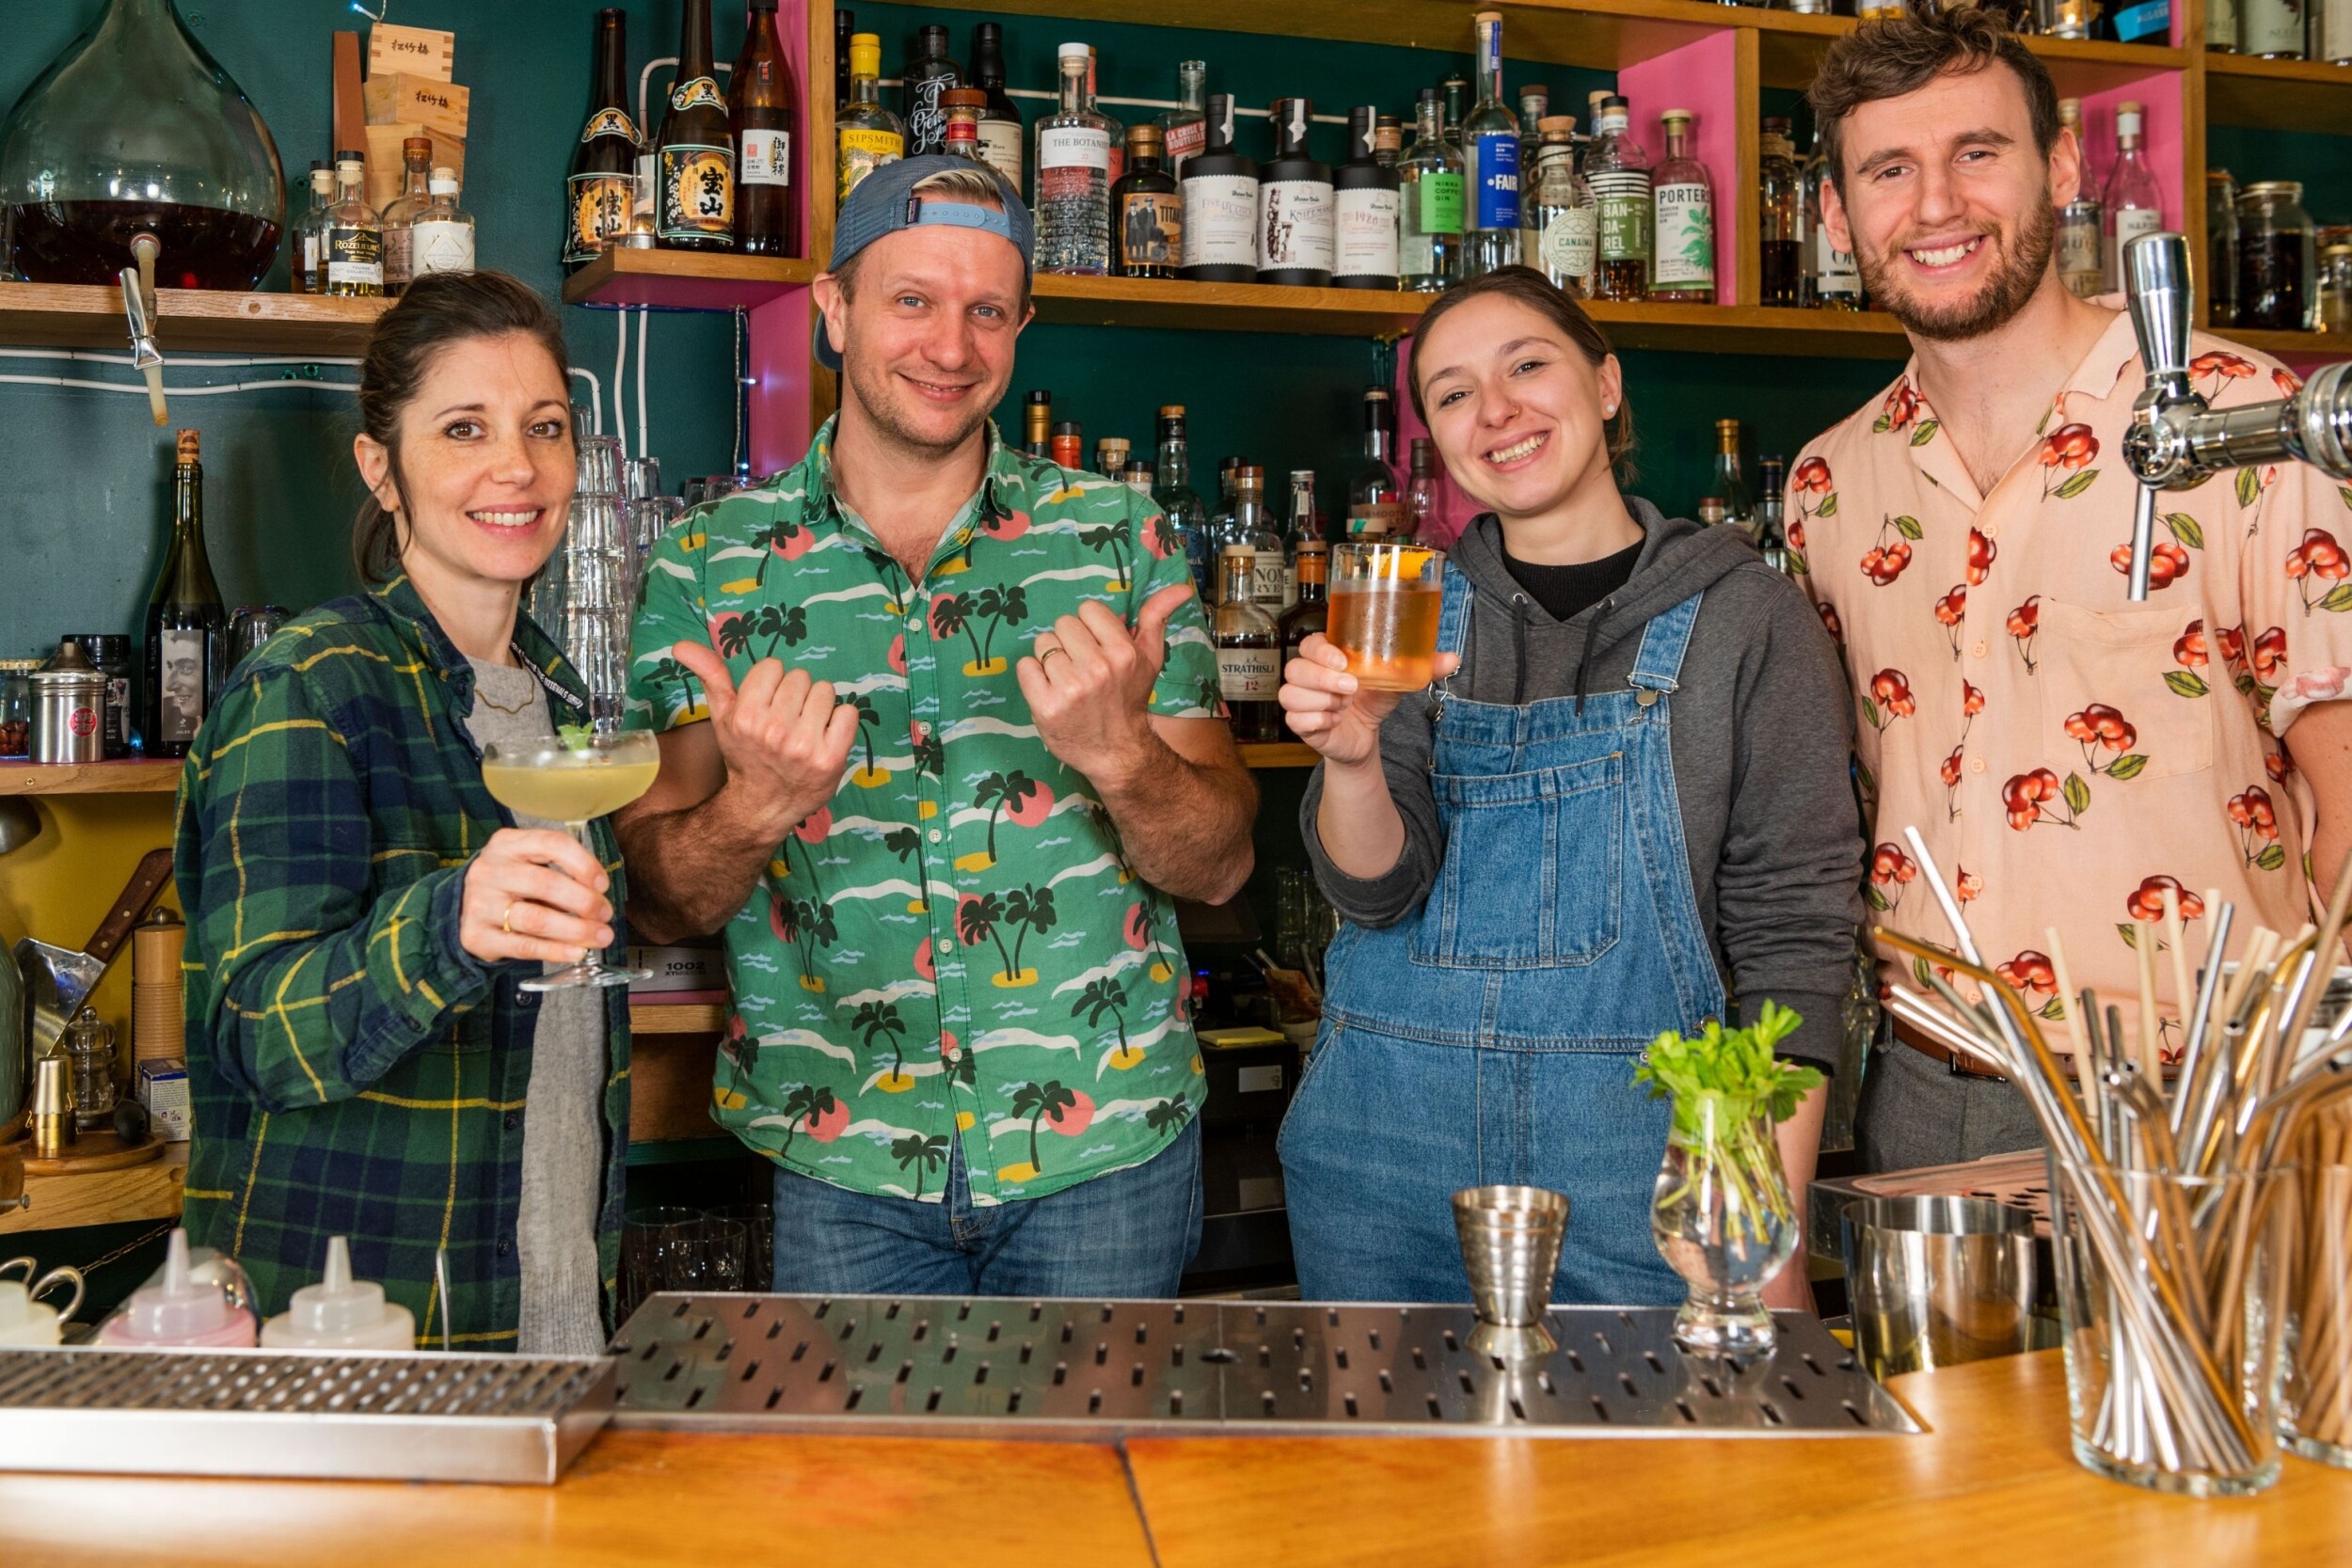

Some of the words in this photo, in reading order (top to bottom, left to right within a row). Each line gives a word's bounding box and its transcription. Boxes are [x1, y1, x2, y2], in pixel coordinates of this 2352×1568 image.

[849, 134, 900, 148] SIPSMITH
[1053, 138, 1071, 147] THE
[1496, 174, 1518, 191] FAIR
[1604, 237, 1625, 250] REL
[666, 962, 705, 971] 1002
